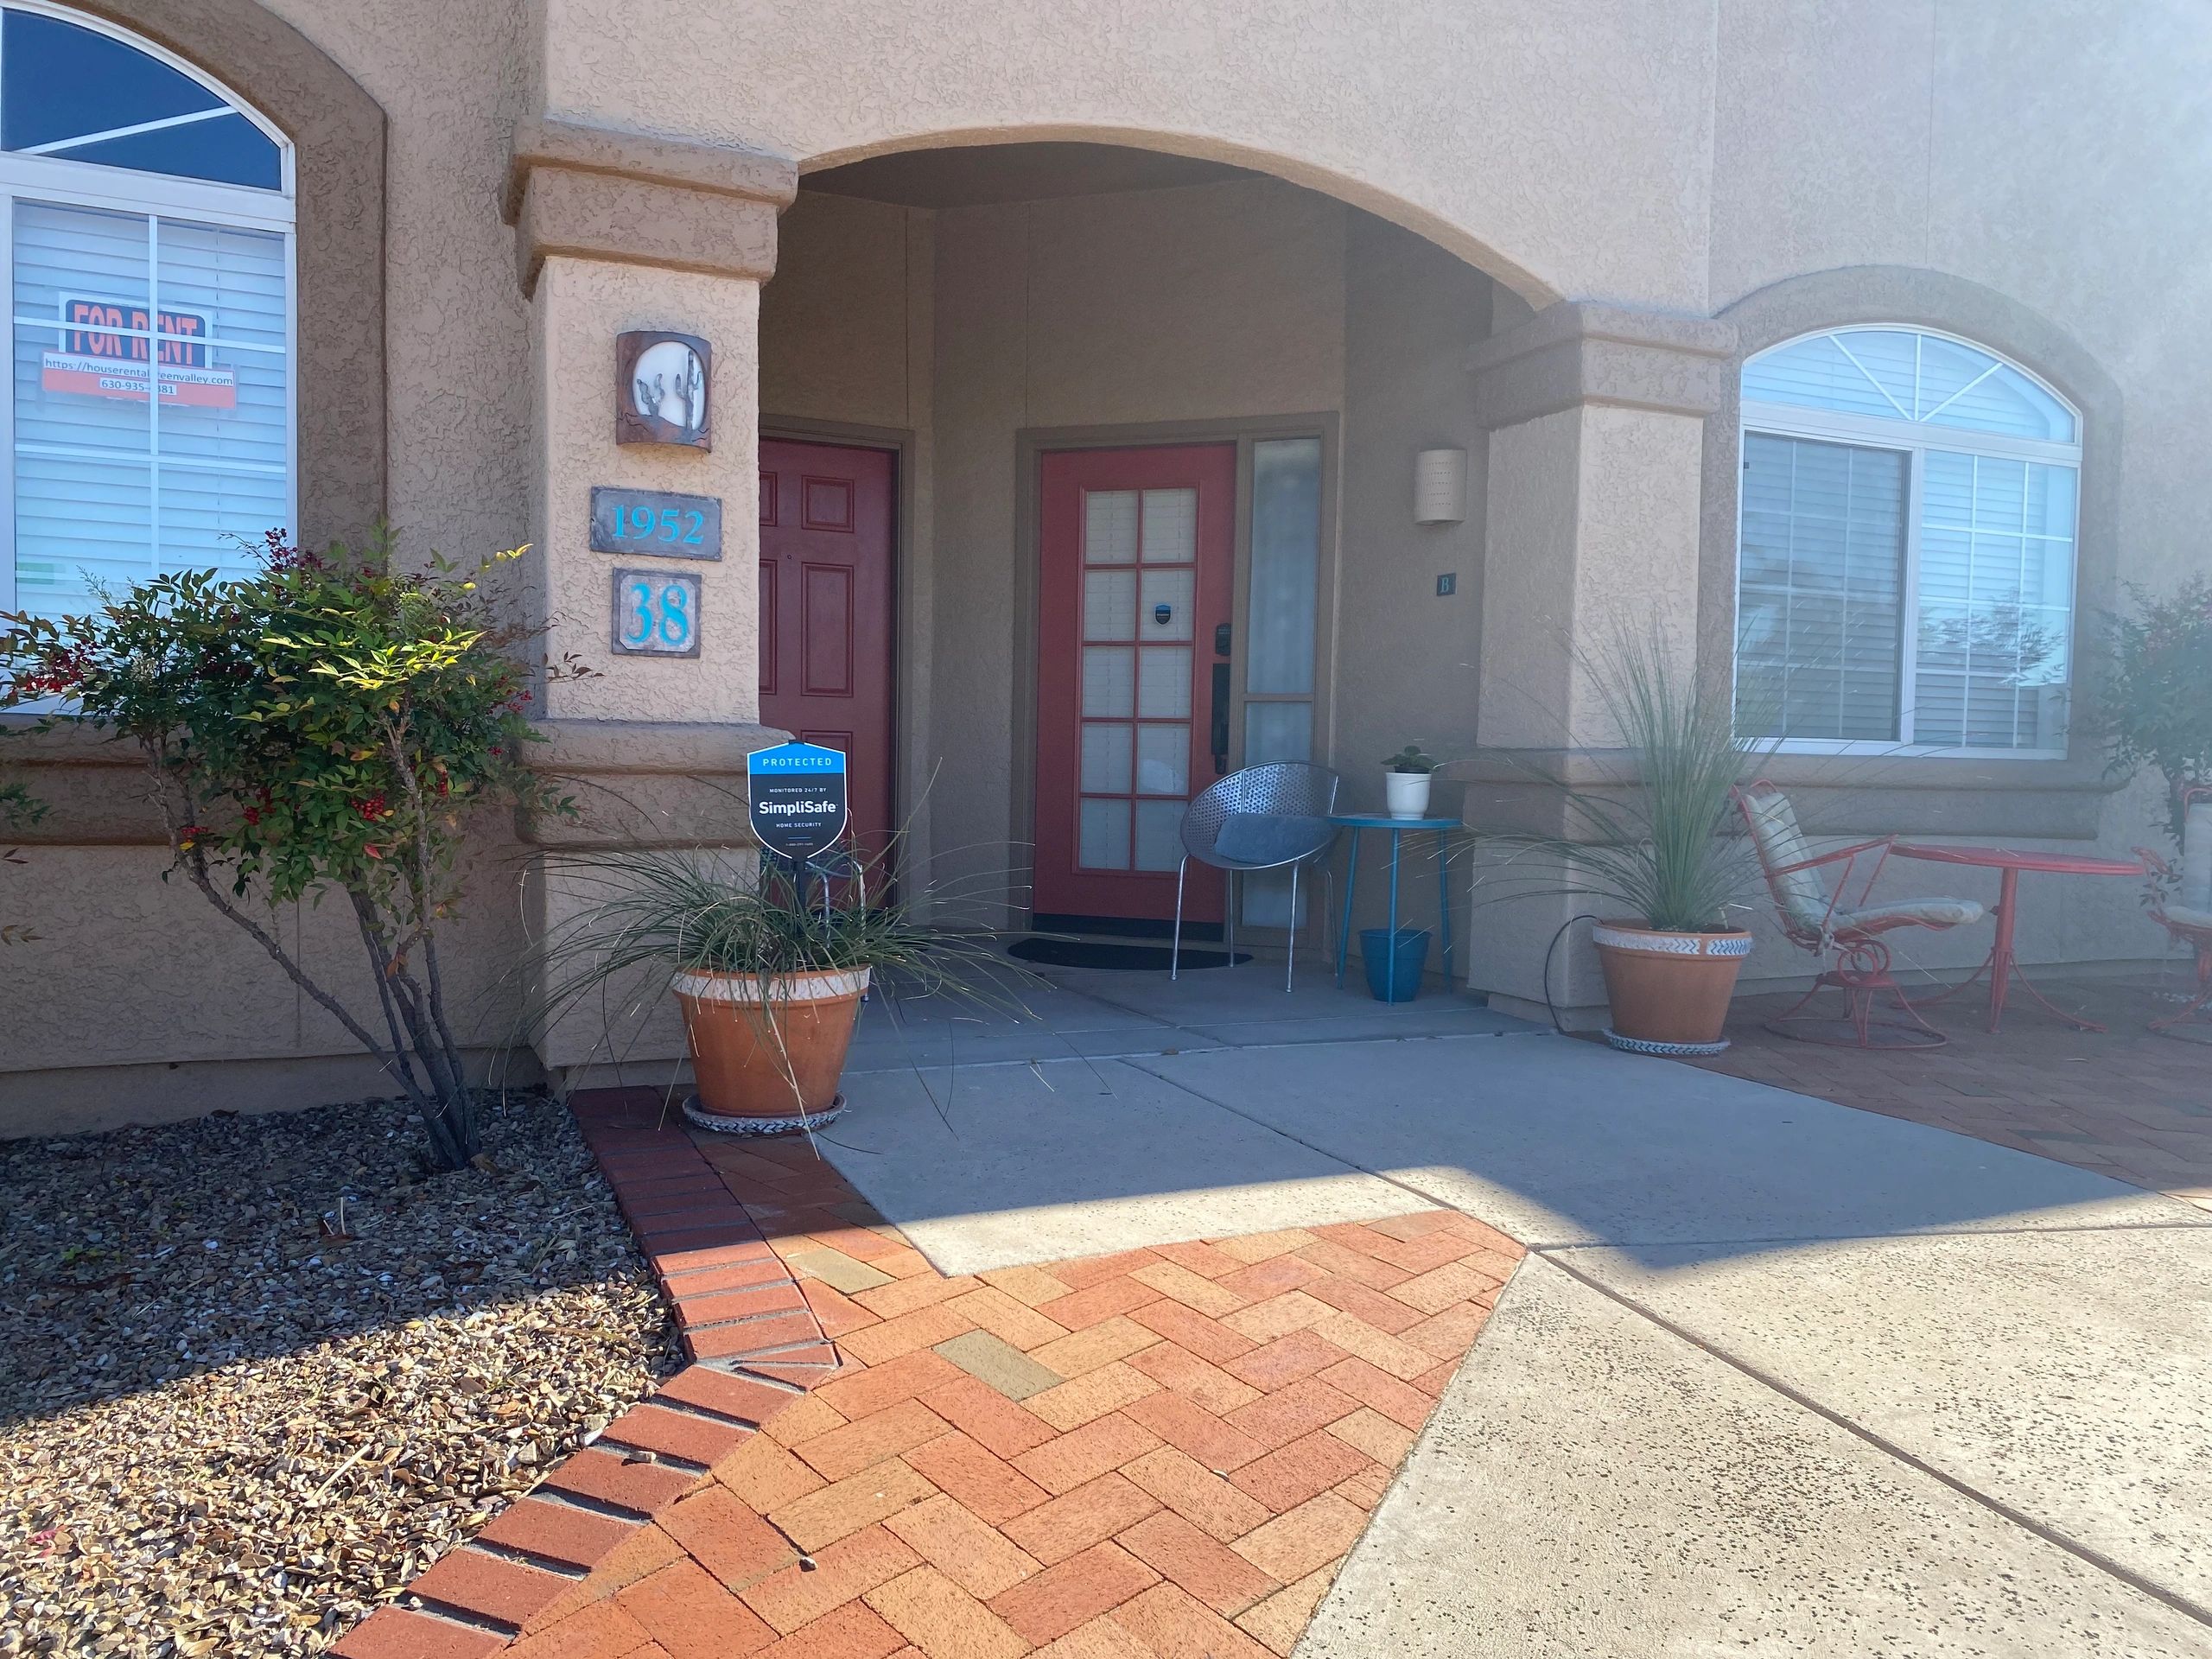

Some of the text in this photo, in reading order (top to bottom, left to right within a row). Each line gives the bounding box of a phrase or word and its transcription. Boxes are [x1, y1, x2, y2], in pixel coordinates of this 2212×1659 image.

[74, 304, 123, 356] FOR
[612, 505, 704, 544] 1952
[1440, 576, 1449, 593] B
[626, 582, 688, 645] 38
[763, 758, 832, 766] PROTECTED
[759, 800, 836, 817] SimpliSafe
